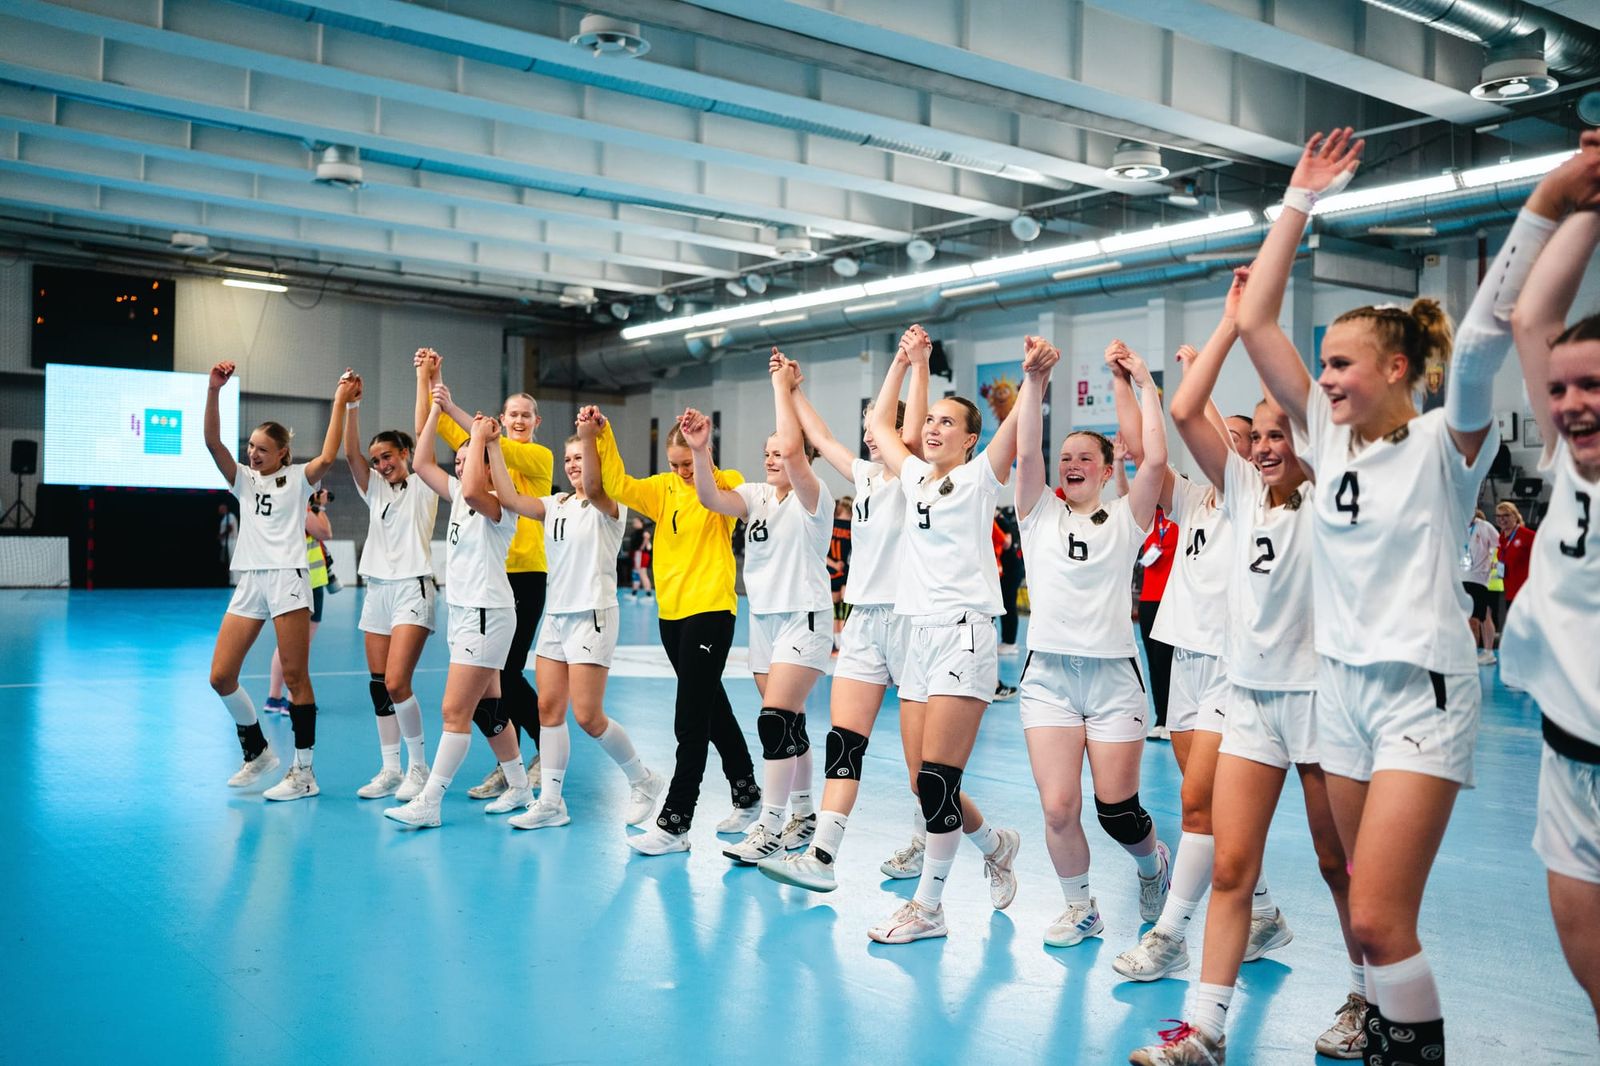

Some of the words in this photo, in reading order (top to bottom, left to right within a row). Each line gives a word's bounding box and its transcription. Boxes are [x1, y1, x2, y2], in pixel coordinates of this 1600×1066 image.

[255, 493, 272, 516] 15
[1335, 471, 1359, 525] 4
[1560, 491, 1591, 558] 3
[1249, 536, 1275, 574] 2
